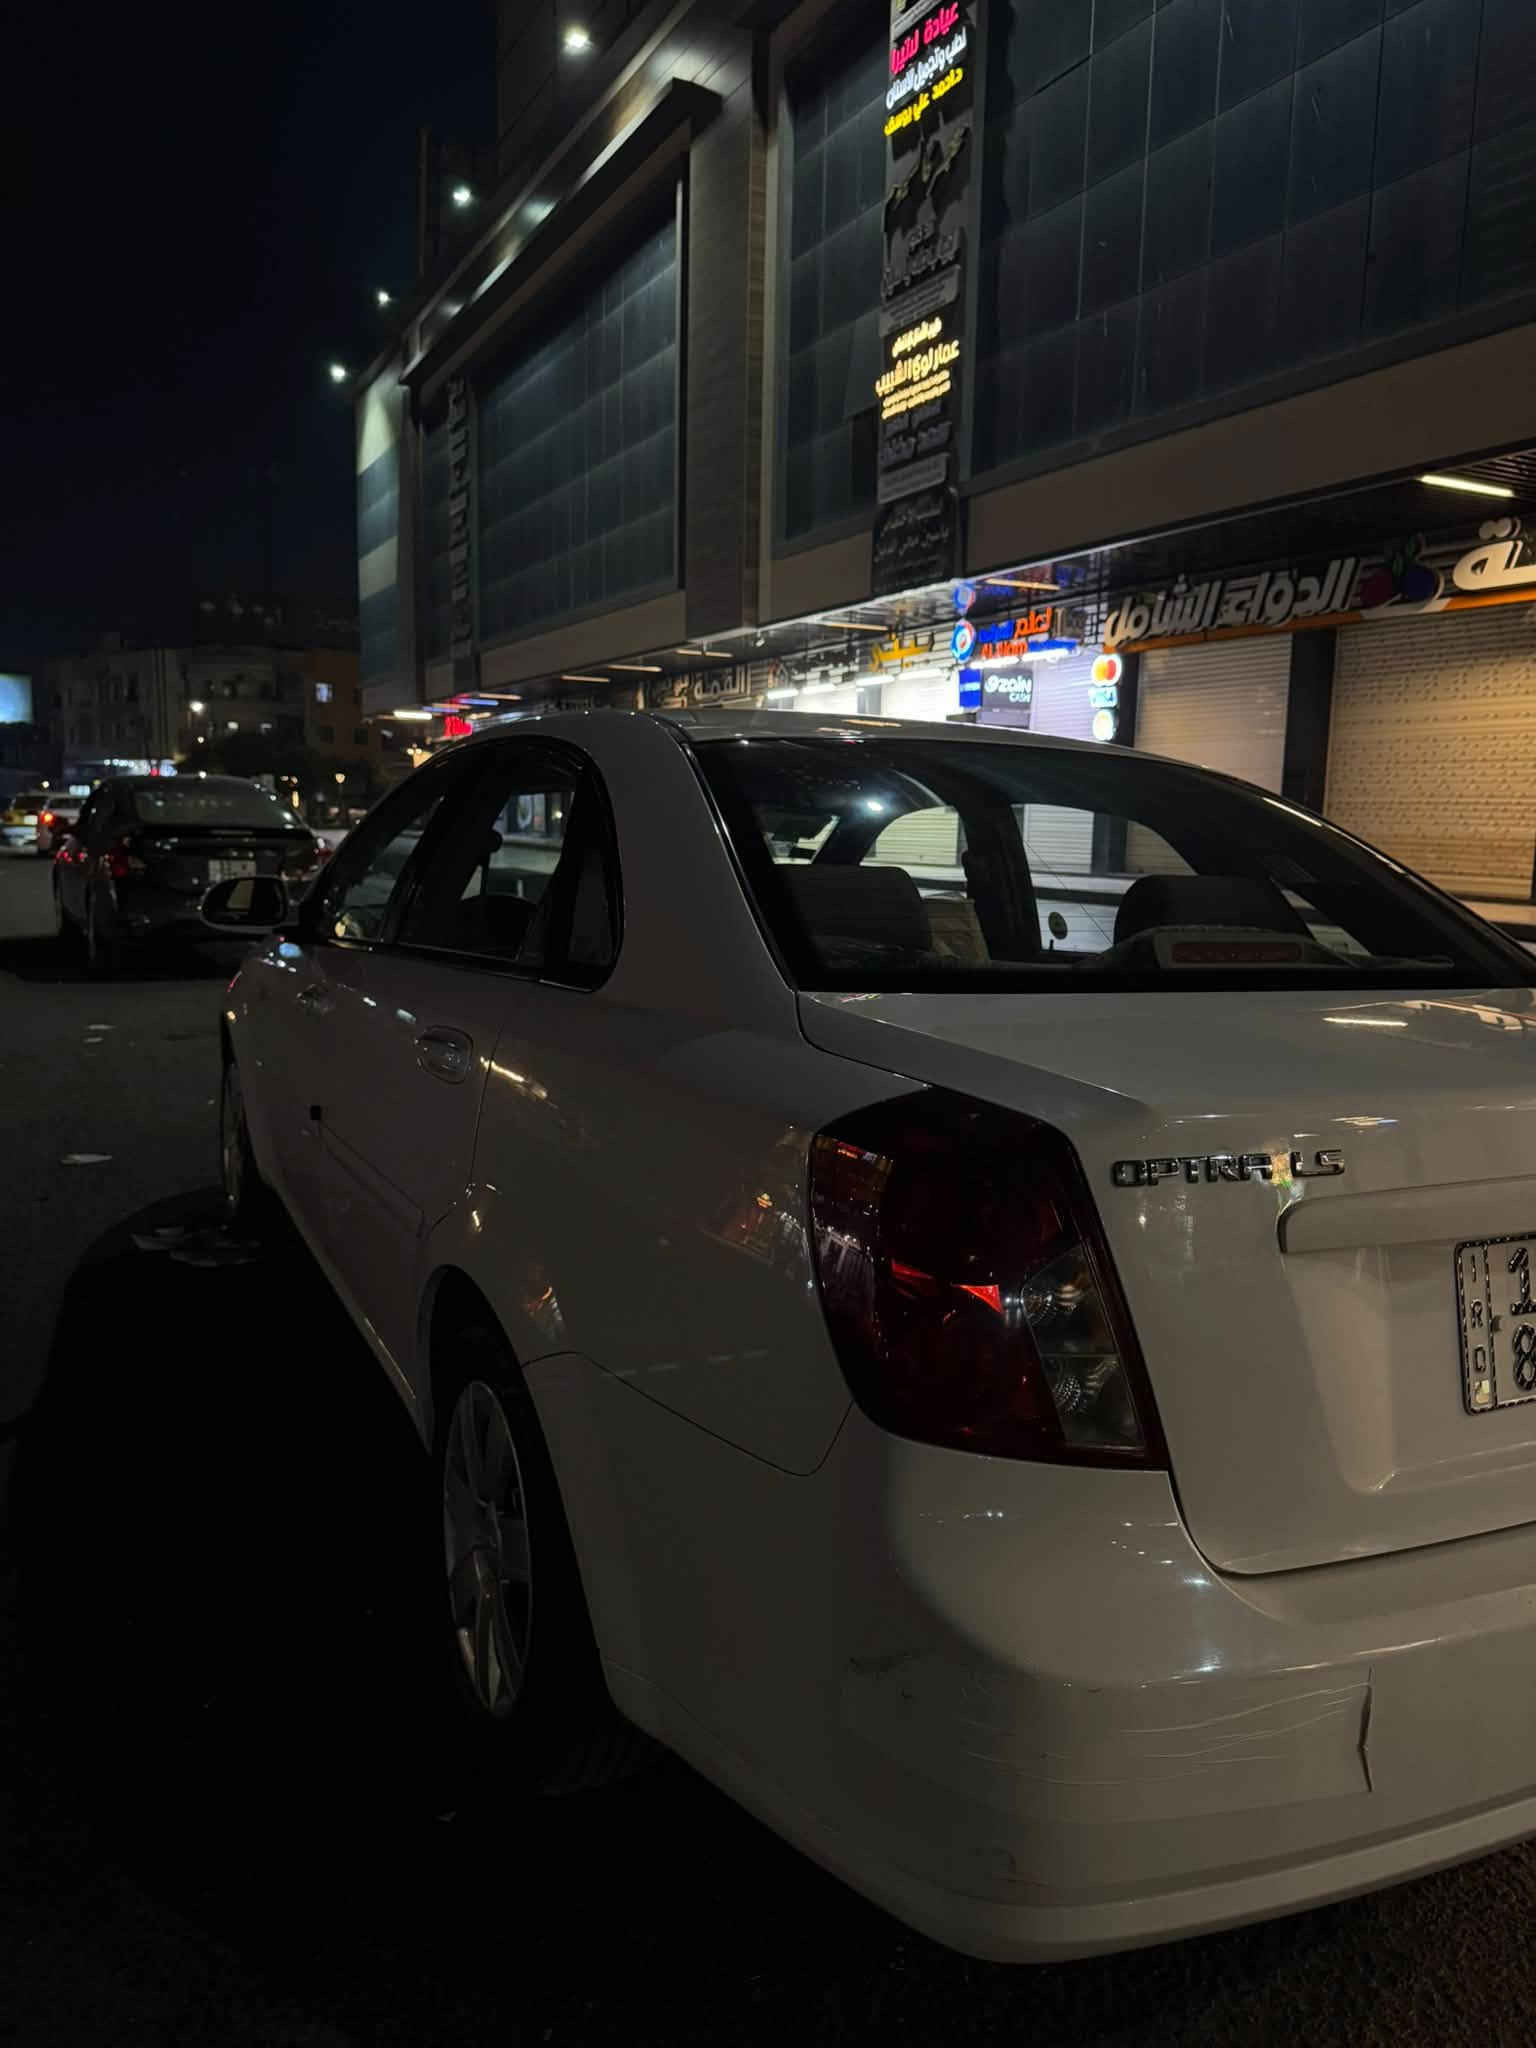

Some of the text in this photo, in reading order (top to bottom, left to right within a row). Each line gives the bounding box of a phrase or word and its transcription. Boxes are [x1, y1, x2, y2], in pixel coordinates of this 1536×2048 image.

[1104, 573, 1224, 647] الشامل
[1112, 1149, 1346, 1188] OPTRA LS
